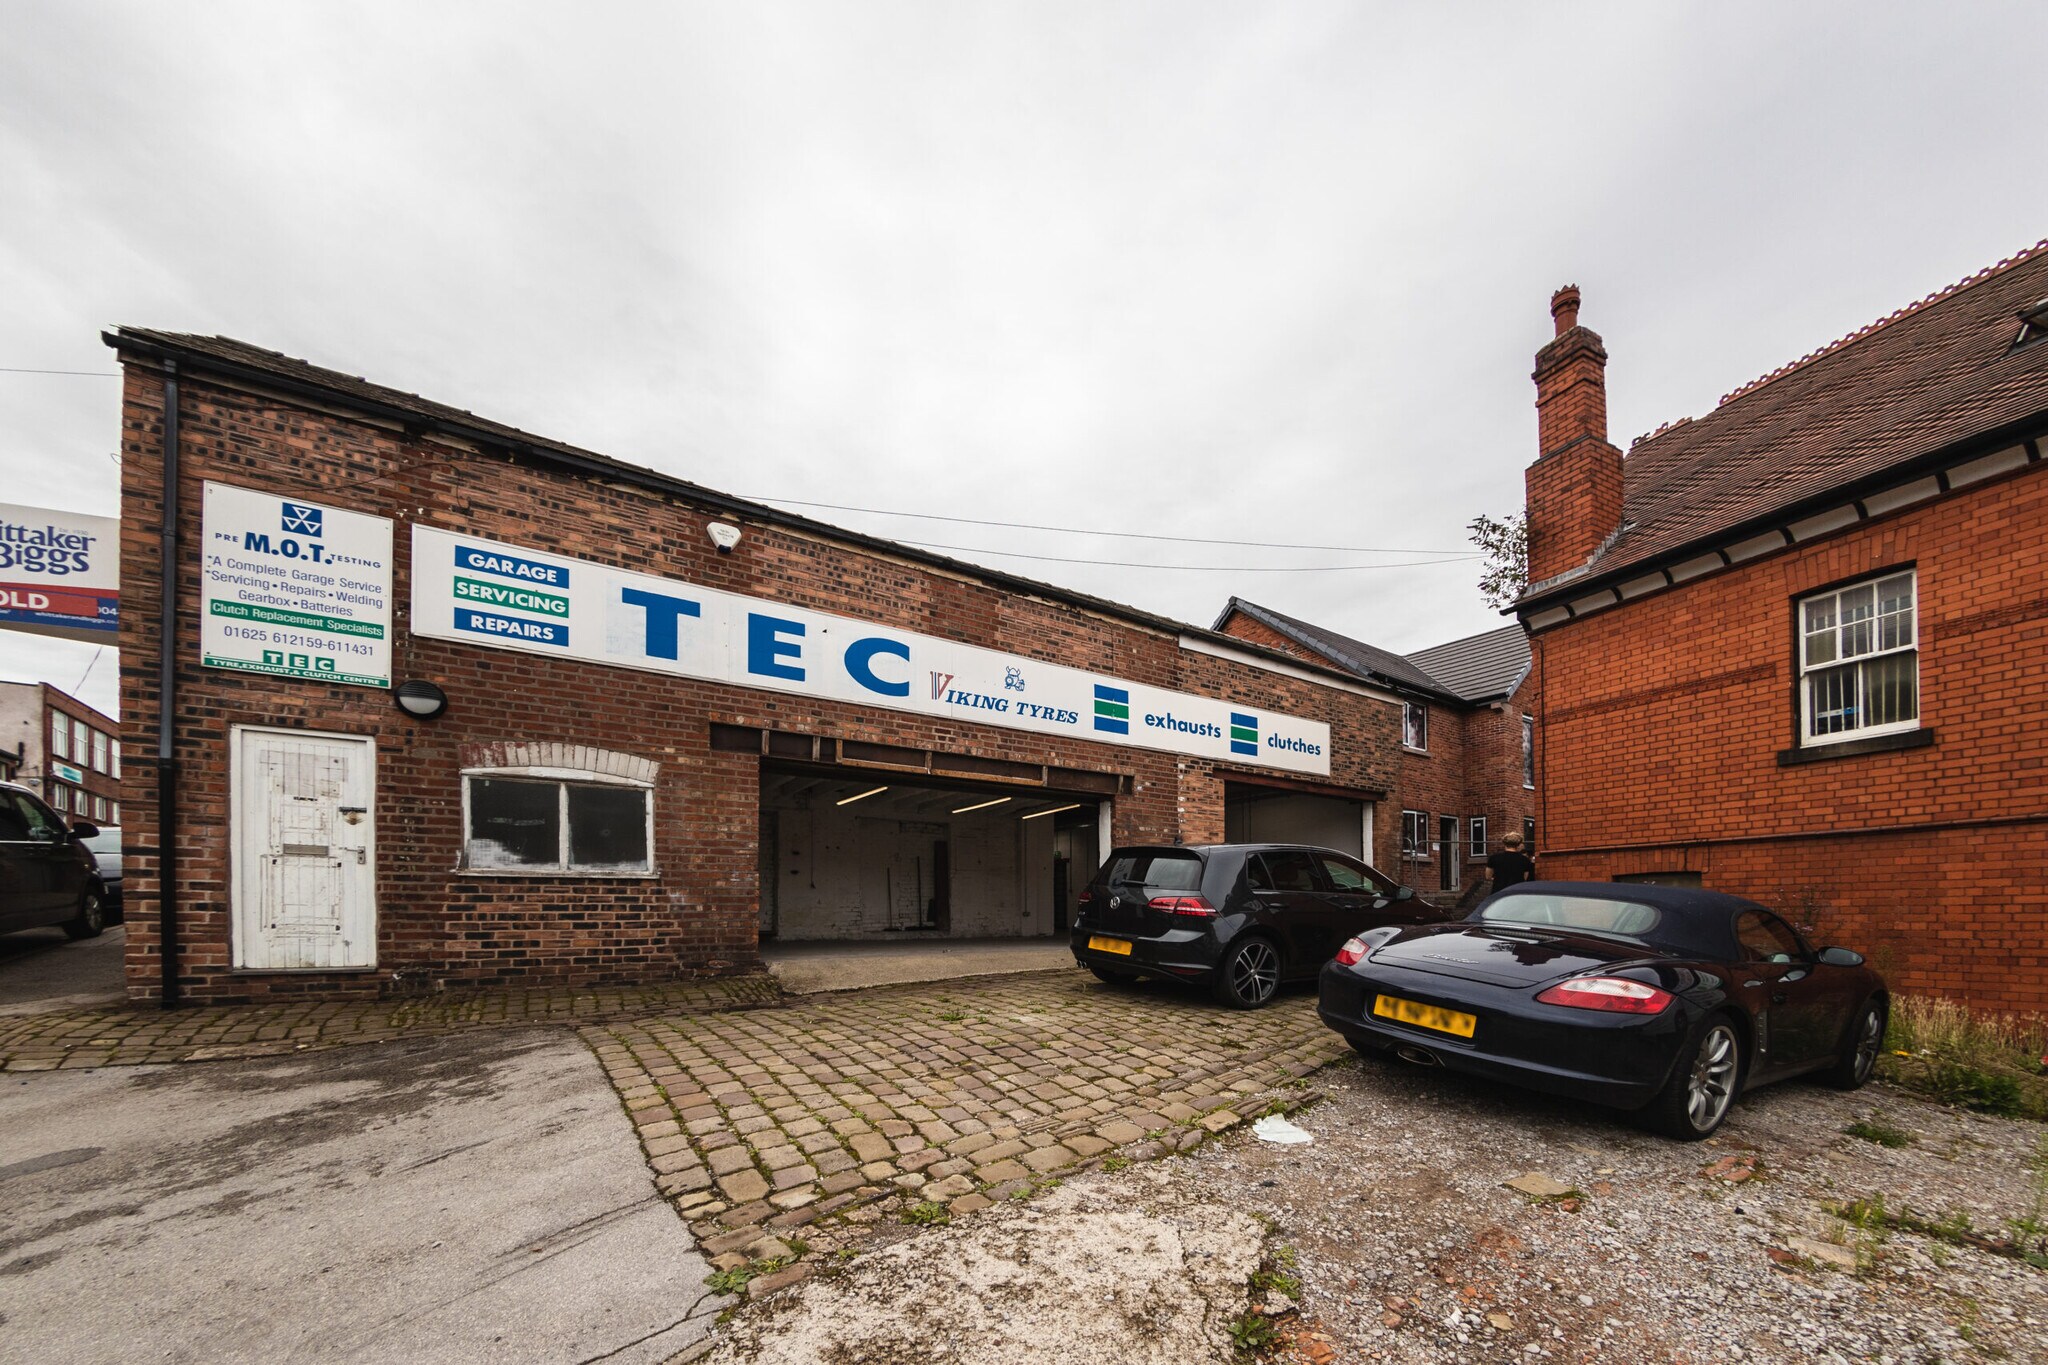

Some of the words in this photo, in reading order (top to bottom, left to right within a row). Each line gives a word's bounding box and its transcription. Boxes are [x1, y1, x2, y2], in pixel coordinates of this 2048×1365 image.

[215, 532, 239, 543] PRE
[244, 531, 333, 565] M.O.T.
[330, 553, 382, 569] TESTING
[212, 556, 222, 567] A
[227, 558, 287, 578] Complete
[292, 569, 335, 586] Garage
[339, 577, 382, 594] Service
[468, 553, 557, 583] GARAGE
[211, 570, 270, 591] Servicing
[280, 581, 327, 599] Repairs
[335, 591, 383, 609] Welding
[238, 589, 291, 607] Gearbox
[300, 599, 353, 617] Batteries
[456, 580, 567, 614] SERVICING
[212, 602, 248, 617] Clutch
[252, 608, 324, 627] Replacement
[327, 619, 383, 636] Specialists
[471, 614, 554, 641] REPAIRS
[224, 625, 267, 641] 01625
[272, 632, 374, 656] 612159-611431
[302, 671, 341, 681] CLUTCH
[343, 675, 380, 686] CENTRE
[930, 671, 1009, 712] VIKING
[1016, 701, 1079, 725] TYRES
[1144, 712, 1221, 738] exhausts
[1267, 733, 1321, 756] clutches
